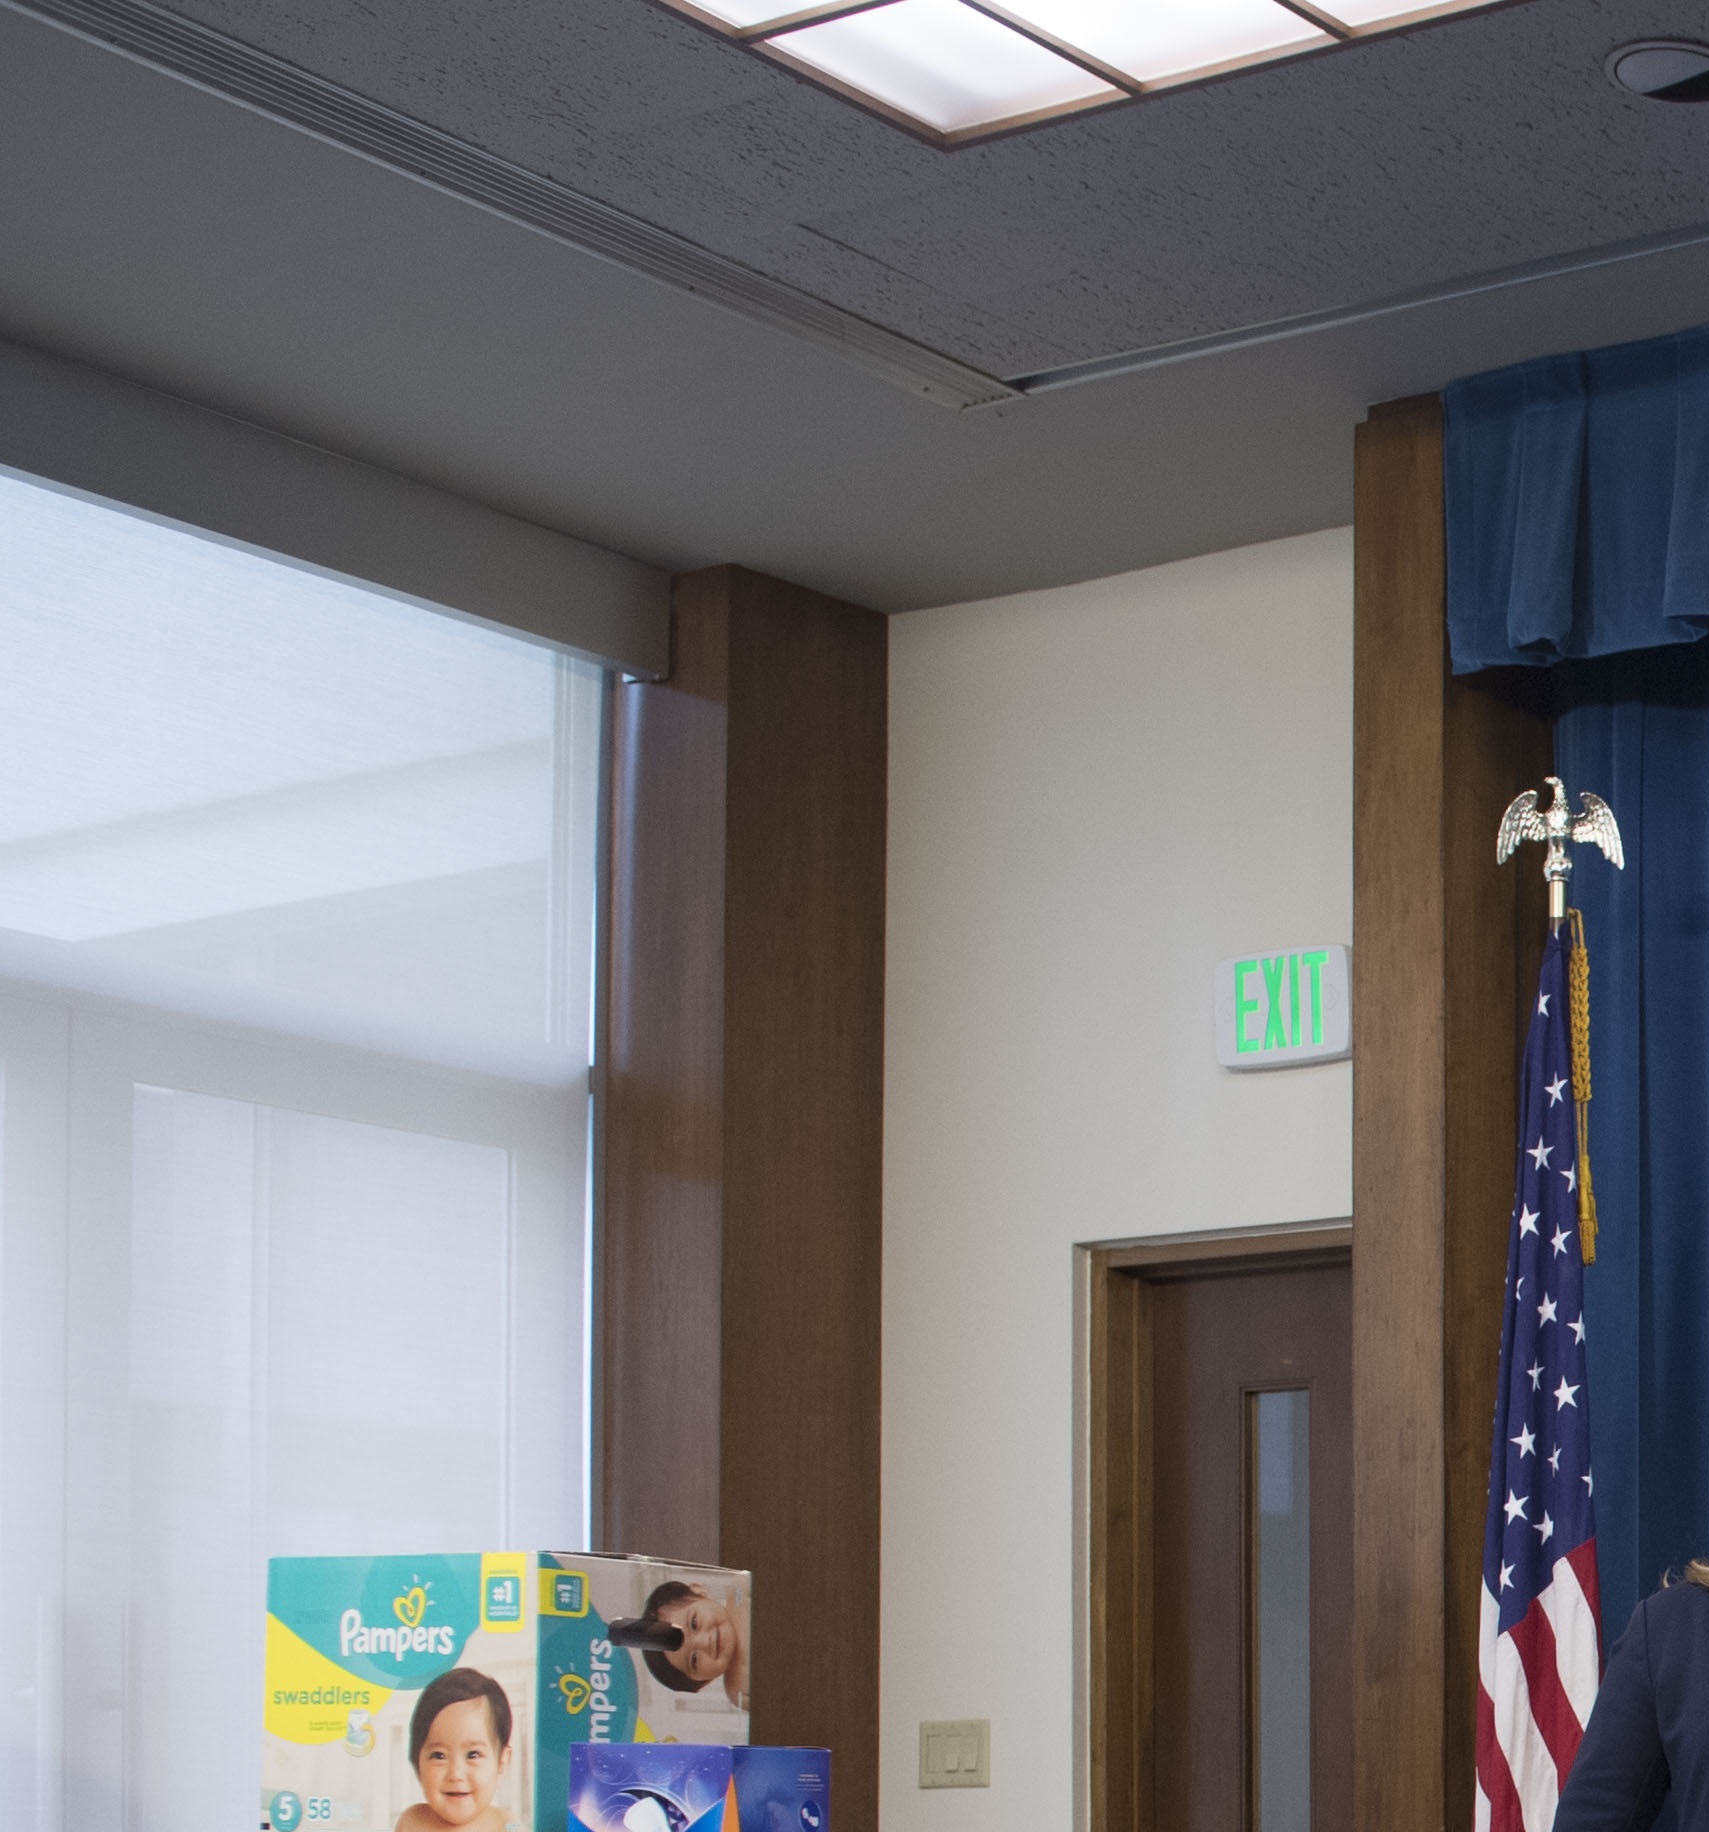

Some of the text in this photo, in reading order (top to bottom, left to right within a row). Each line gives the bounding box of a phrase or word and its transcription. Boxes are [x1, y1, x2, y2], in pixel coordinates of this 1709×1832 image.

[1235, 951, 1329, 1053] EXIT
[340, 1608, 455, 1661] Pampers
[272, 1686, 370, 1705] swaddlers
[278, 1795, 331, 1821] 5 58
